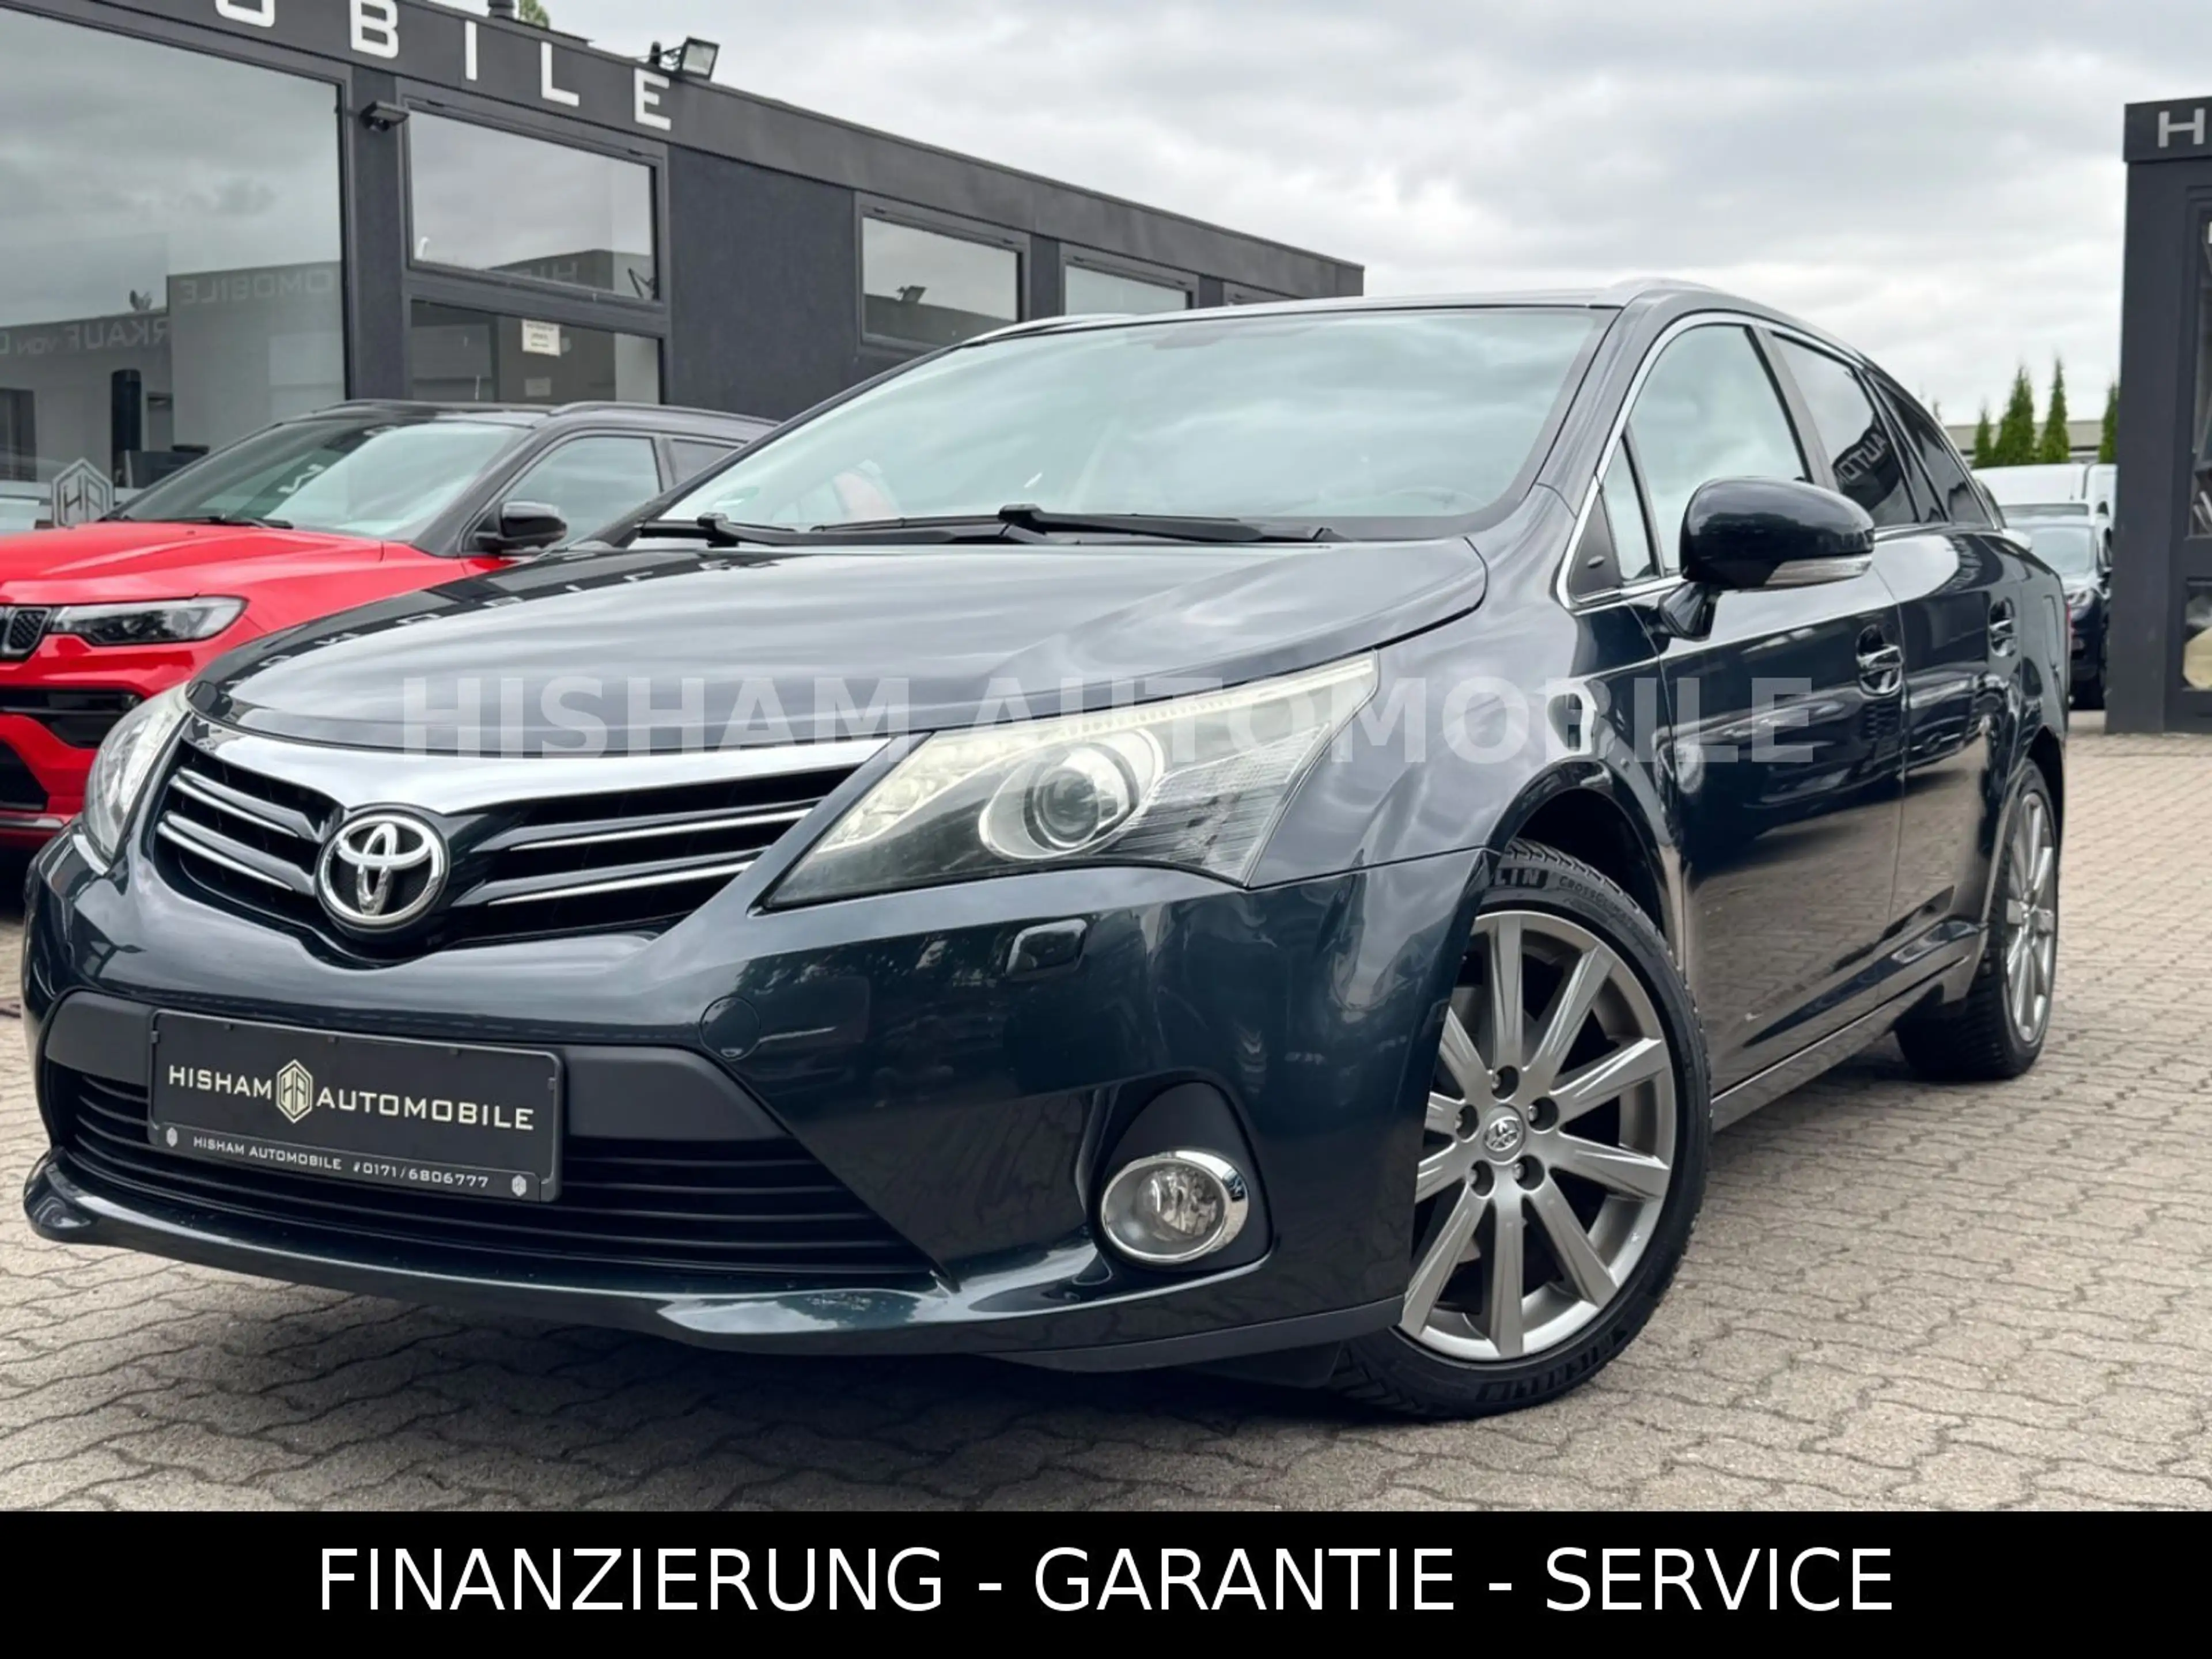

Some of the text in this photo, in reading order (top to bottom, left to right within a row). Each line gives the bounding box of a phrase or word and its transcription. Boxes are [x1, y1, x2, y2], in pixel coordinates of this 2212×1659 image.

[169, 1065, 272, 1100] HISHAM
[316, 1086, 535, 1131] AUTOMOBILE
[193, 1136, 245, 1156] HISHAM
[248, 1145, 342, 1171] AUTOMOBILE
